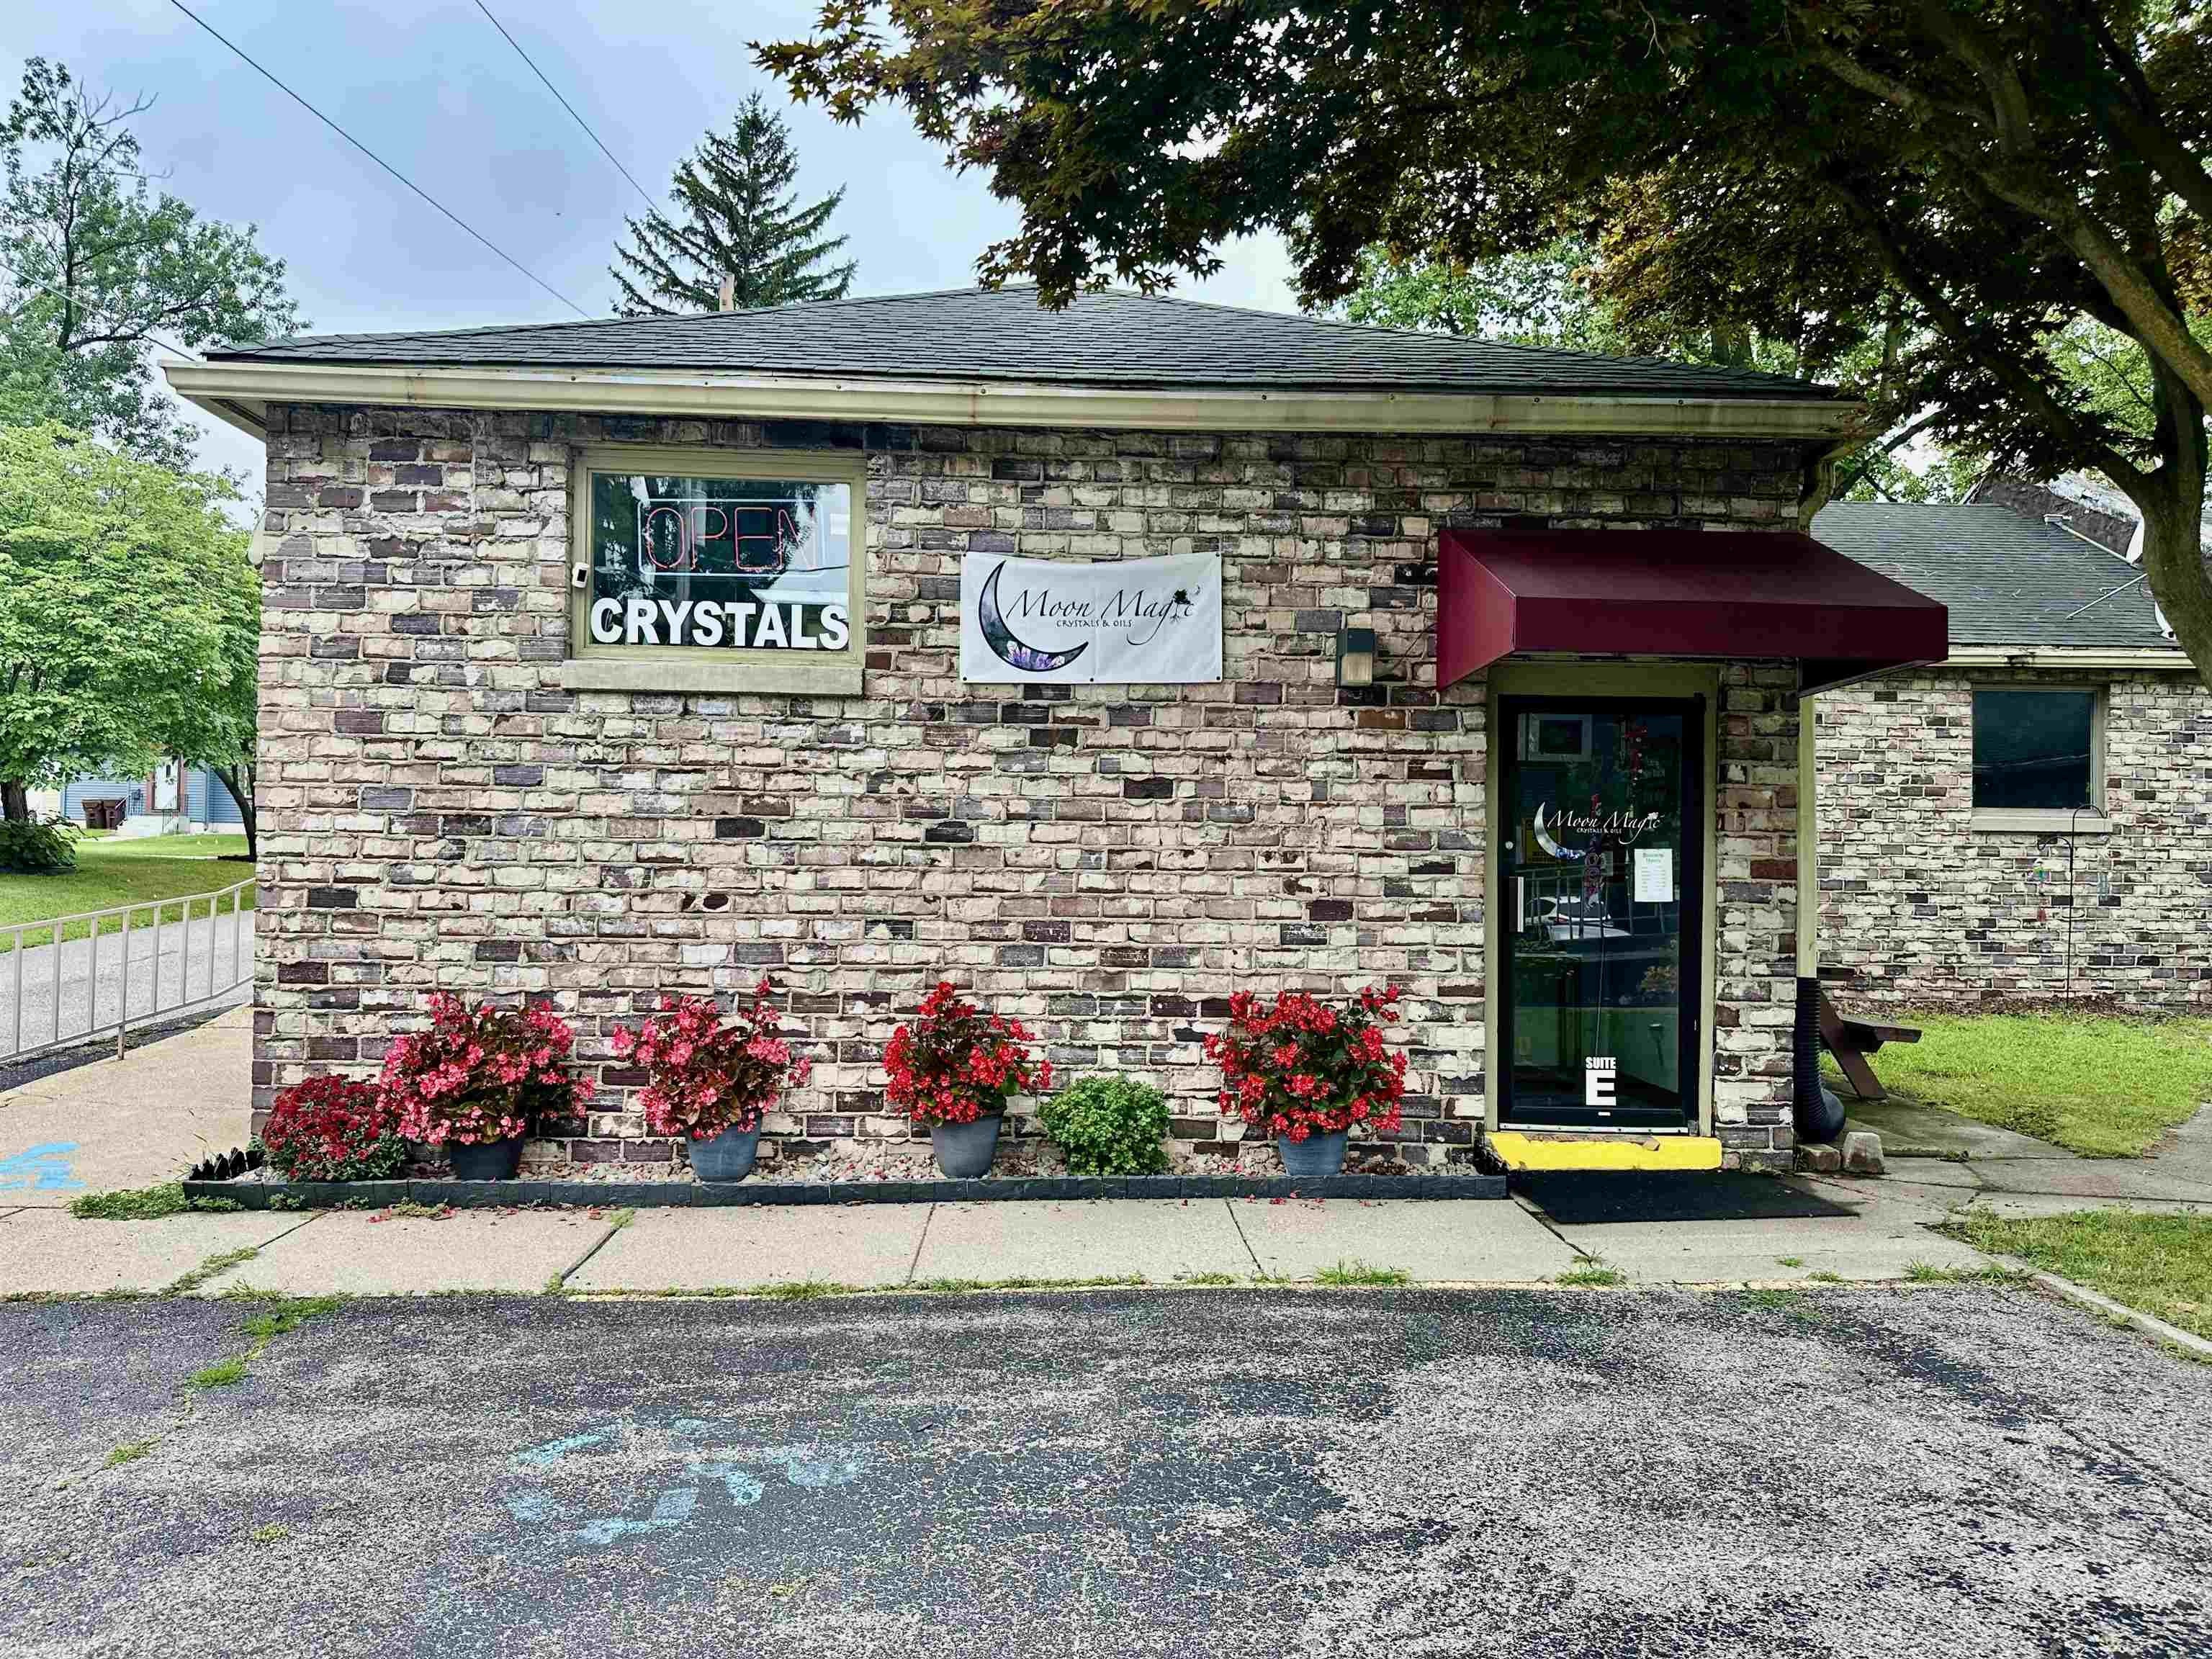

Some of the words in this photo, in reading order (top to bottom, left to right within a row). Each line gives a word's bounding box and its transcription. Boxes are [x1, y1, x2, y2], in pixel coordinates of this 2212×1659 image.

[647, 507, 815, 570] OPEN
[590, 598, 850, 650] CRYSTALS
[1007, 589, 1095, 619] Moon
[1101, 588, 1195, 646] Magic
[1547, 809, 1601, 827] Moon
[1603, 810, 1661, 845] Magic
[1586, 1056, 1617, 1069] SUITE
[1586, 1069, 1617, 1106] E
